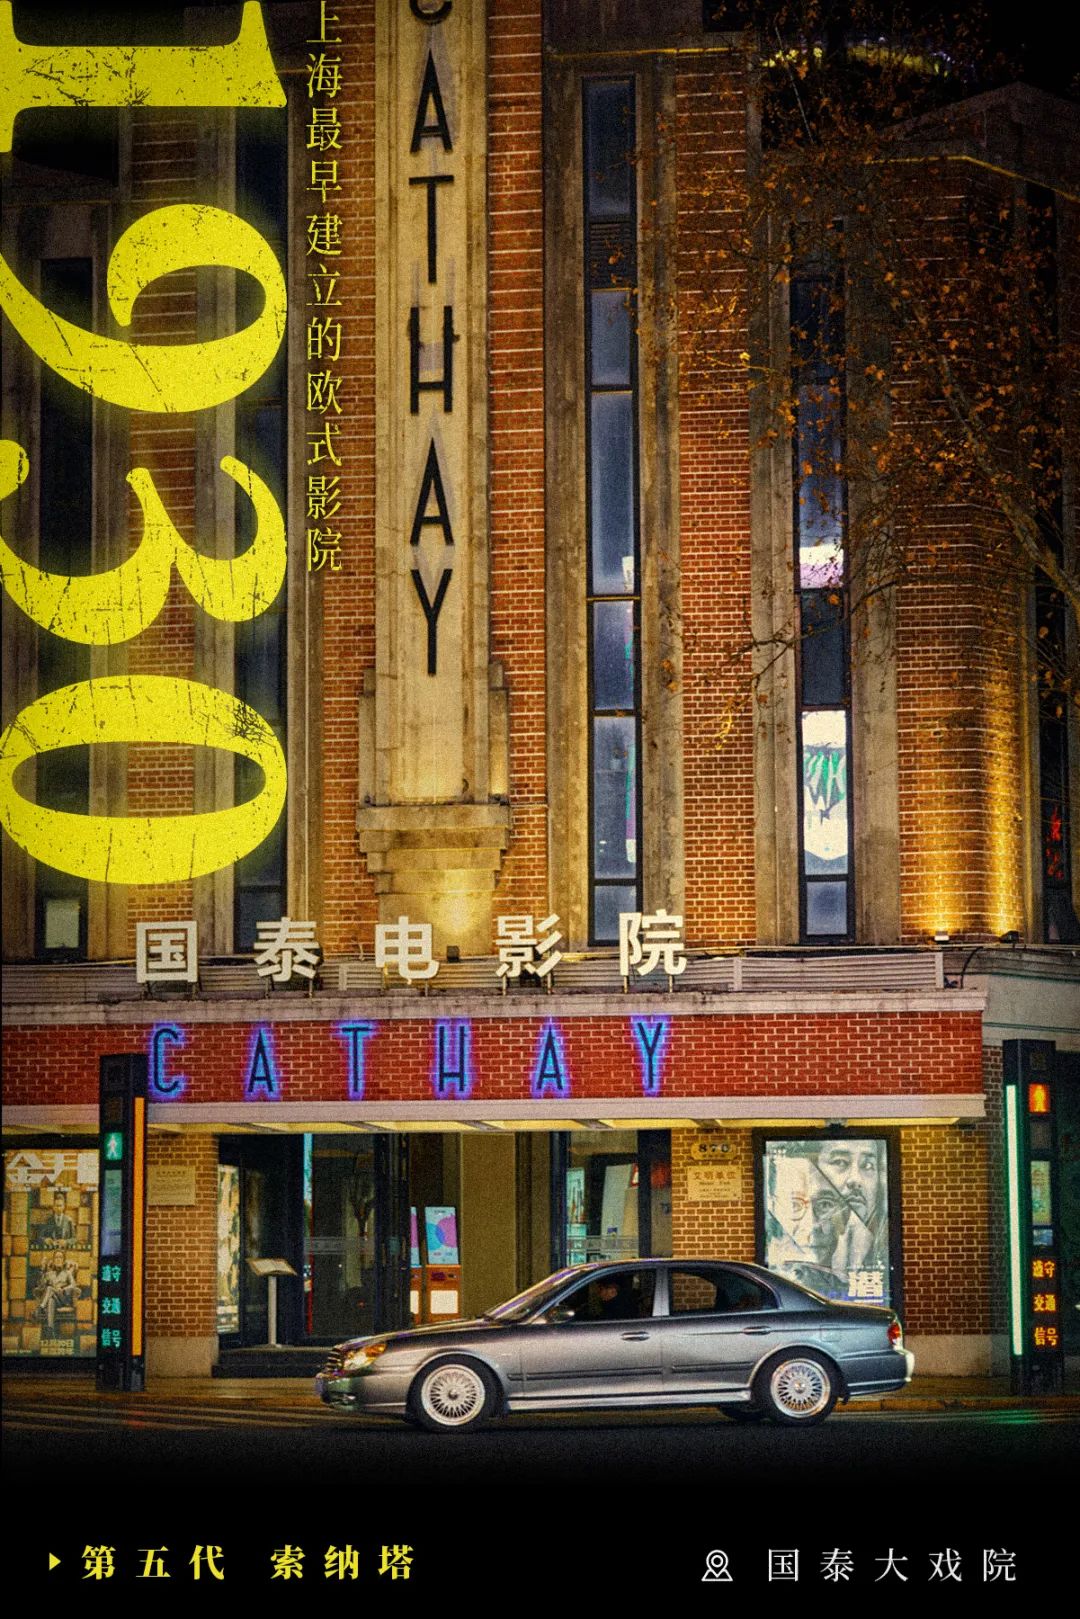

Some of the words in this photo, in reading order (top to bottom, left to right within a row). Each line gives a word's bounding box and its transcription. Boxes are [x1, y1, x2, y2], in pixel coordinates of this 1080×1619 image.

[409, 0, 455, 676] ATHAY
[135, 909, 688, 983] 国泰电影院
[150, 1020, 673, 1096] CATHAY
[1035, 1327, 1058, 1346] 信号
